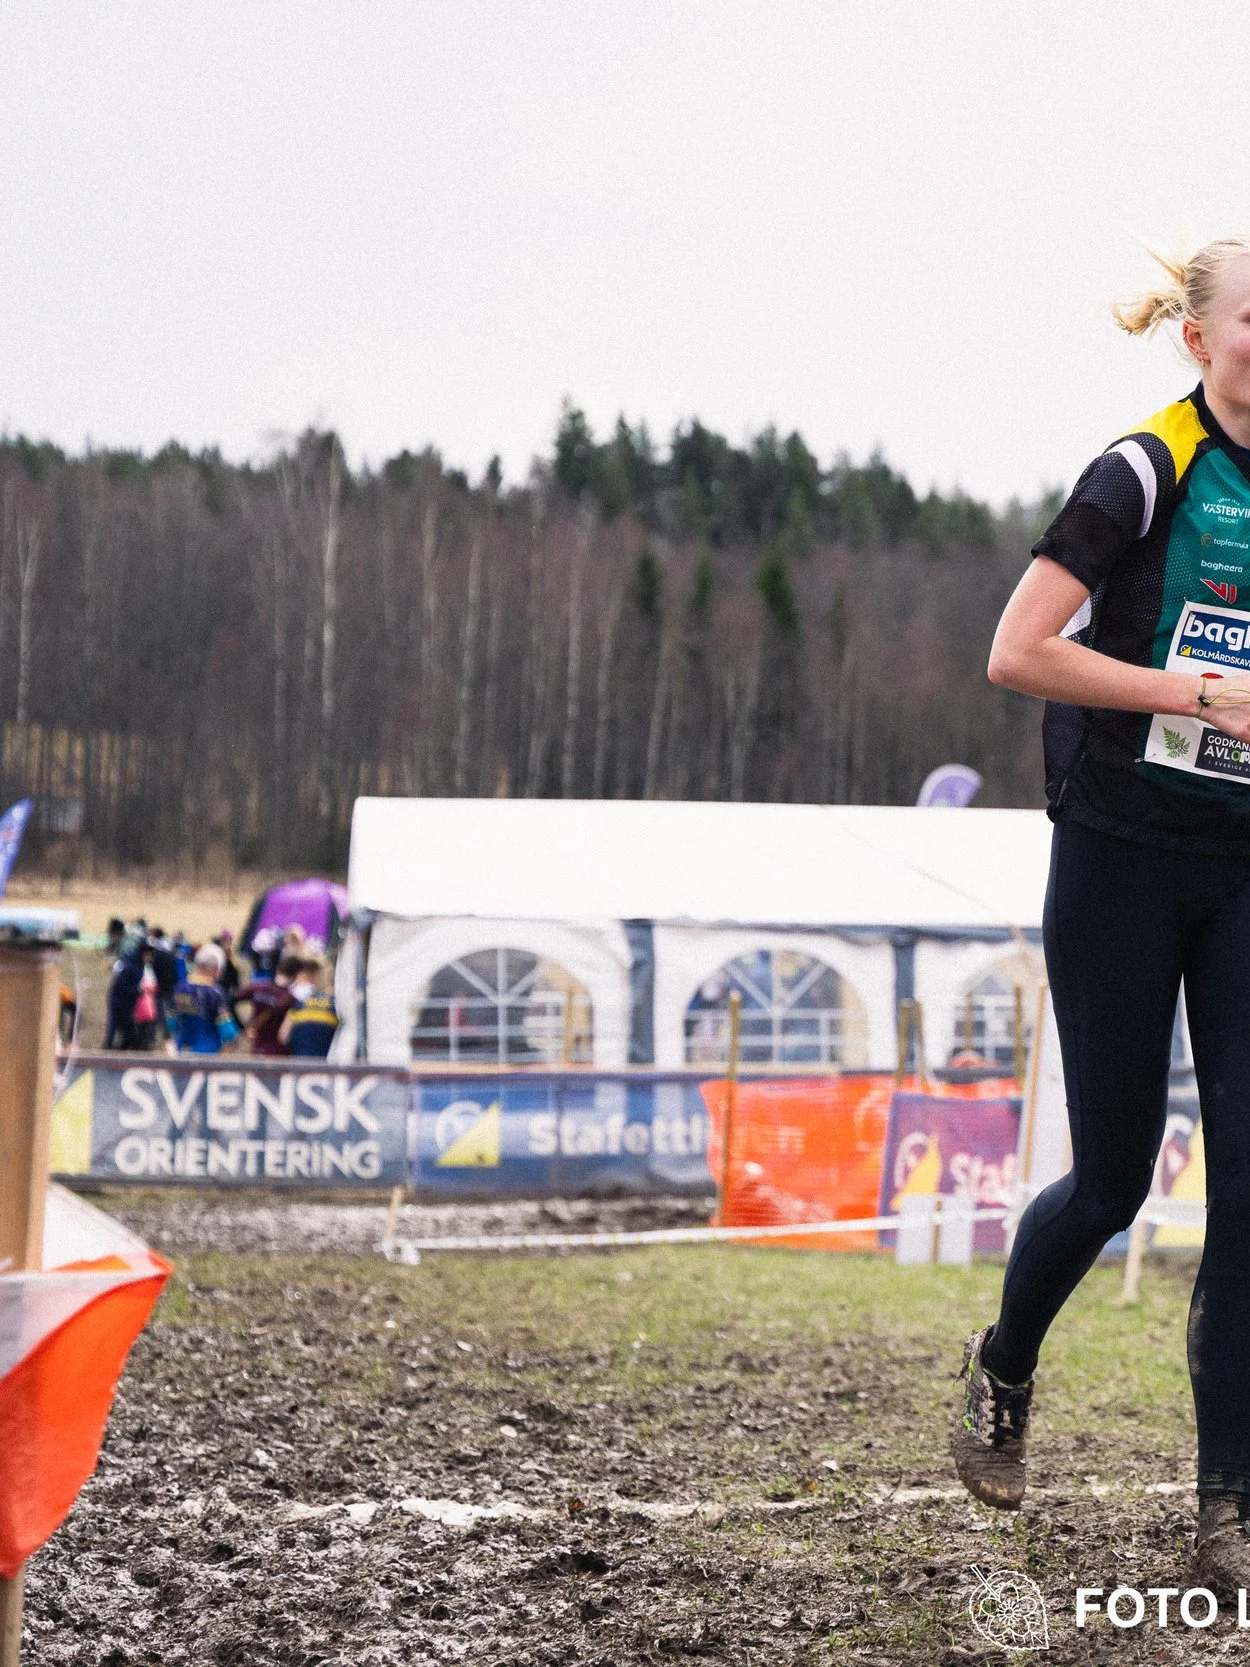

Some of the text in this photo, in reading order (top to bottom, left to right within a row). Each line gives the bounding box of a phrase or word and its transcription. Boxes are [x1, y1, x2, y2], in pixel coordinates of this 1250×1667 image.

[1217, 516, 1239, 525] RESORT
[1200, 560, 1243, 573] bagheera
[118, 1066, 382, 1134] SVENSK
[114, 1135, 383, 1180] ORIENTERING
